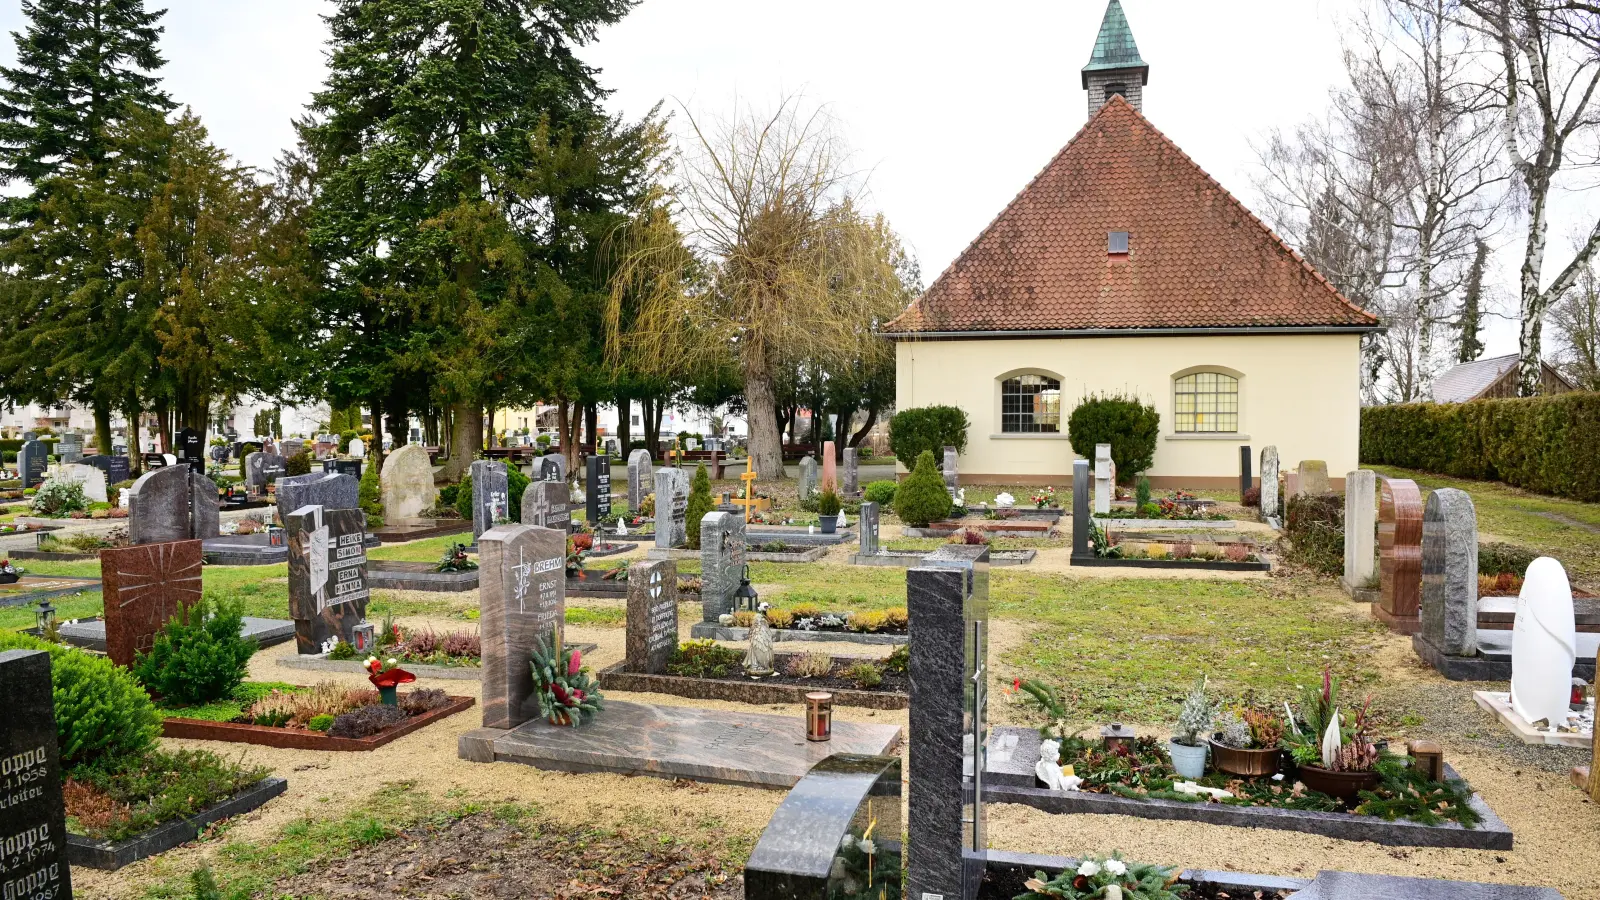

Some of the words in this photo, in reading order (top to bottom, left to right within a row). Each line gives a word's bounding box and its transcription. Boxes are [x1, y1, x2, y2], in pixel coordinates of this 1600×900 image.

[534, 557, 562, 574] BREHM
[339, 569, 358, 580] ERNA
[336, 581, 361, 594] HANNA
[539, 580, 557, 591] ERNST
[537, 609, 559, 622] FRIEDA
